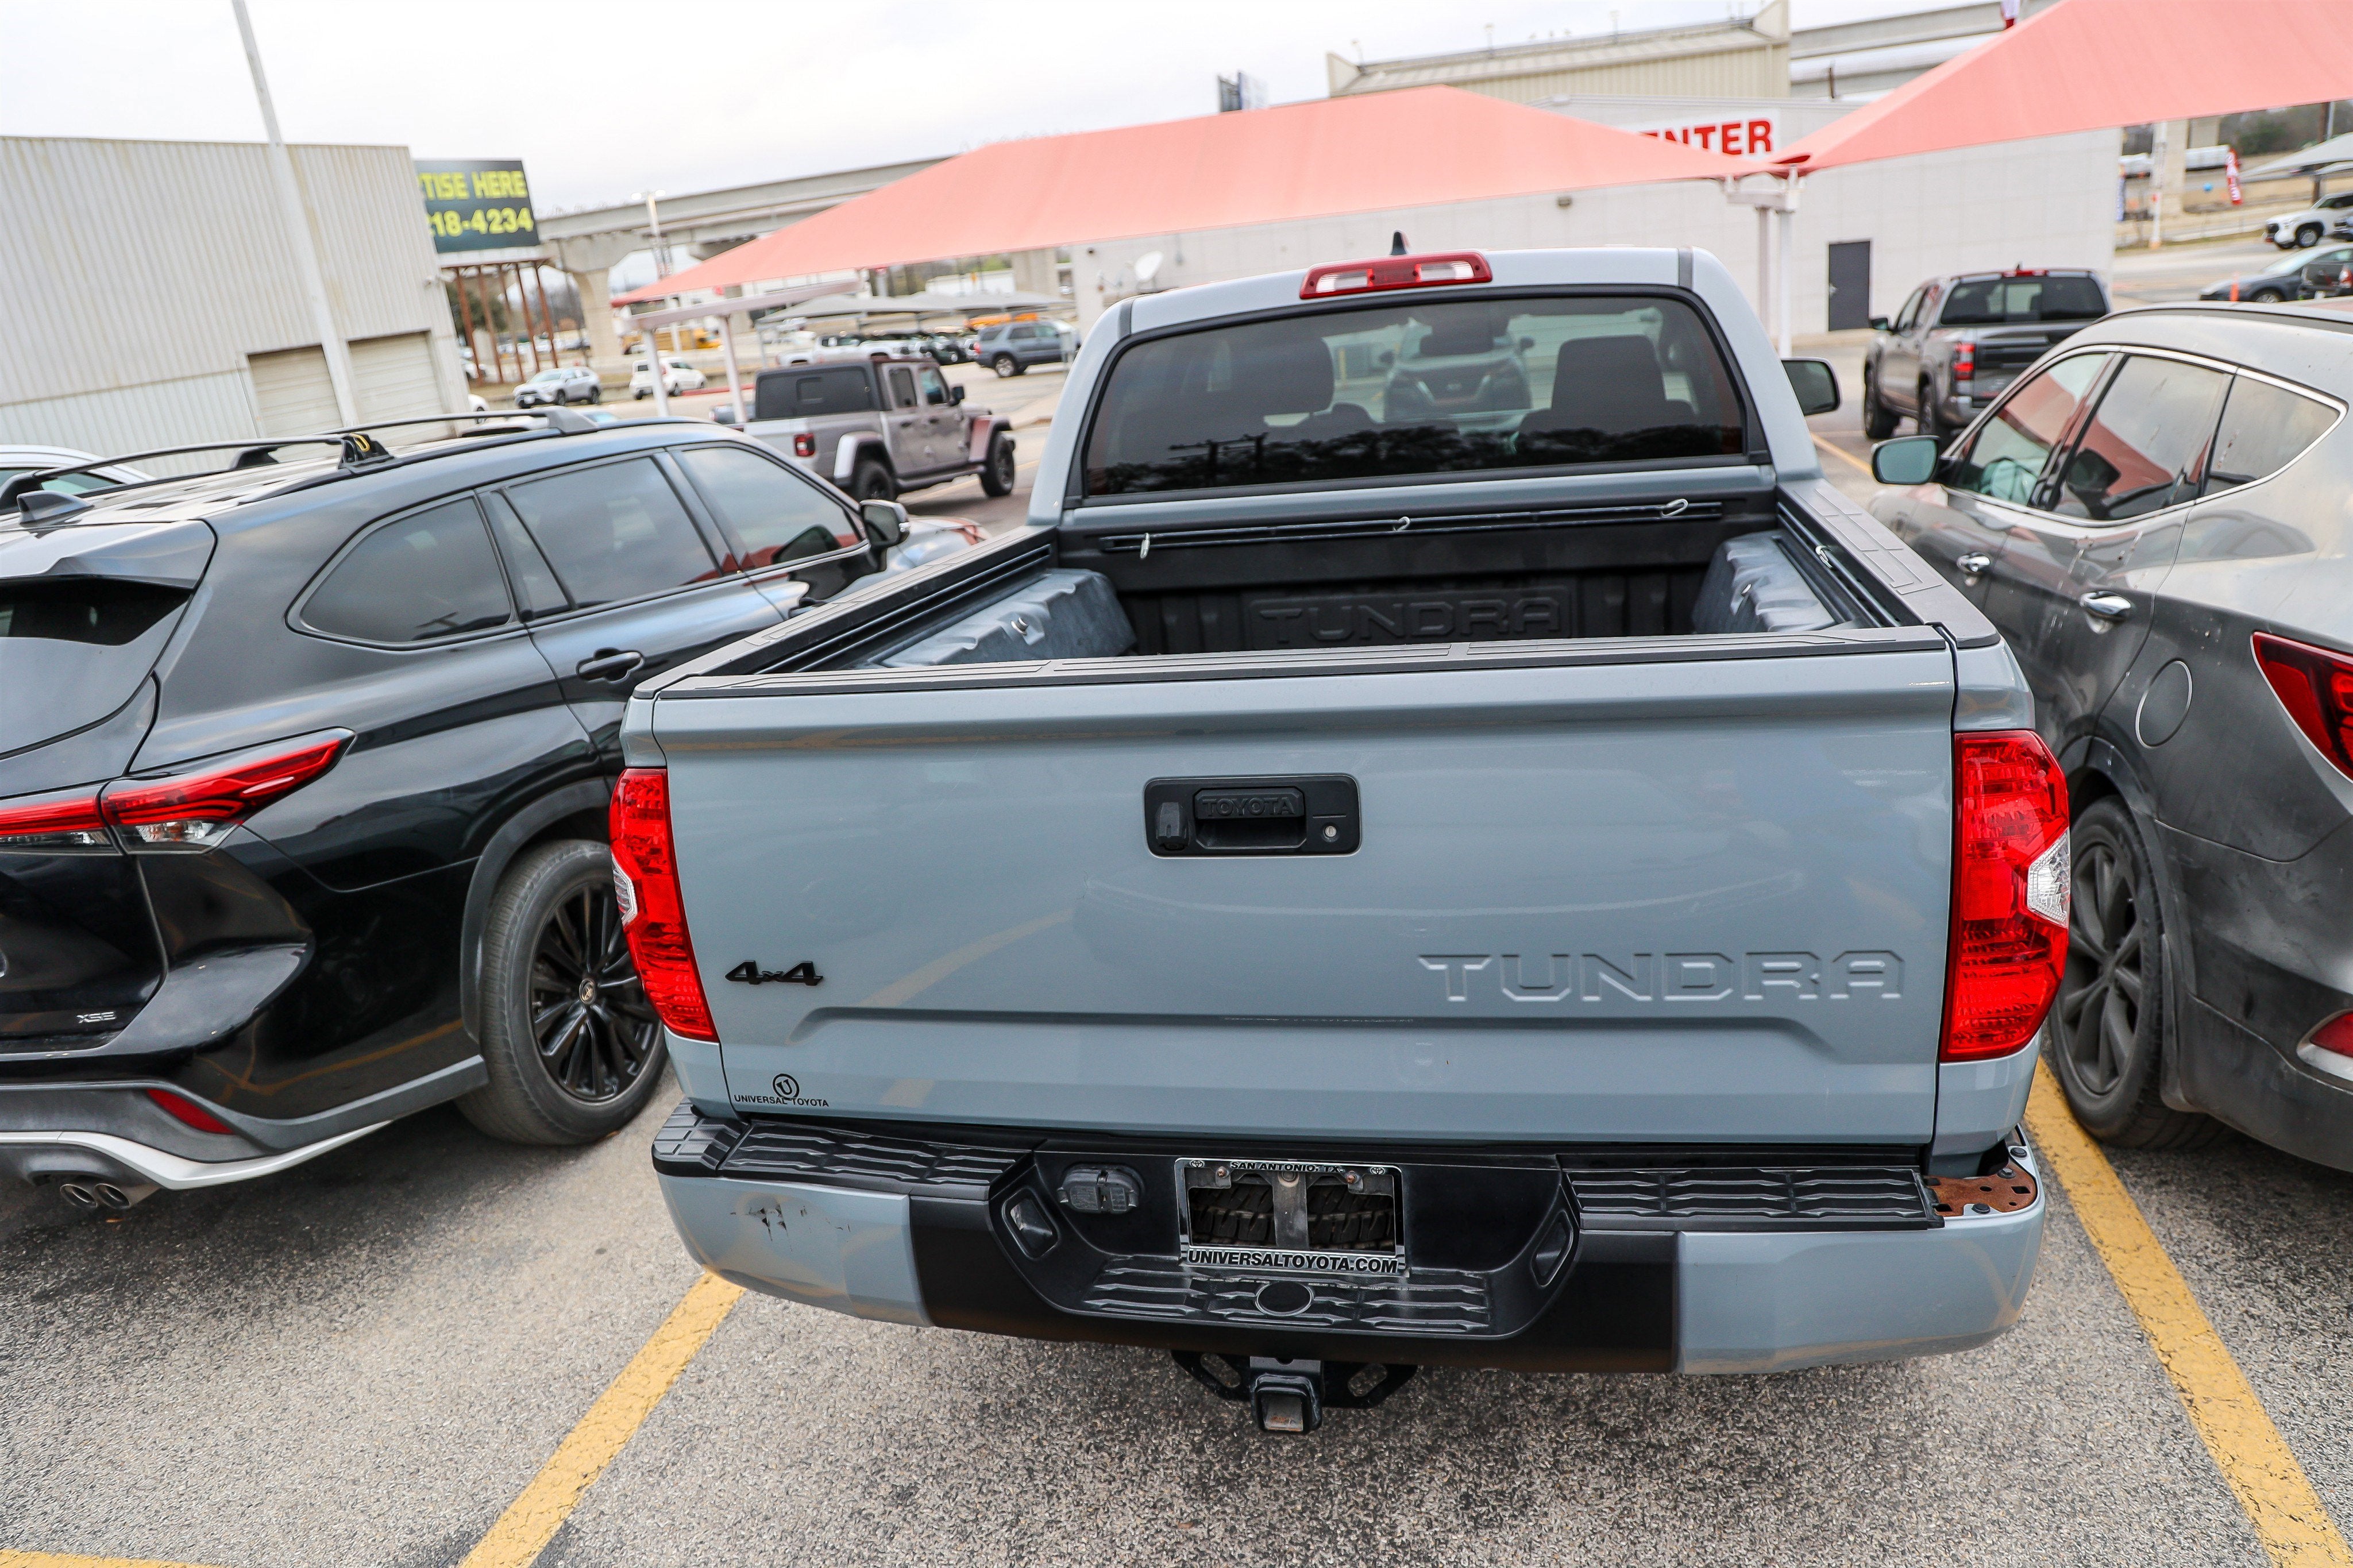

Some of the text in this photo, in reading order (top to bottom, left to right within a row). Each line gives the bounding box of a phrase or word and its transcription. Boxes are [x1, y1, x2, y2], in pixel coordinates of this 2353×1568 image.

[419, 171, 527, 200] TISE HERE
[427, 207, 534, 237] 18-4234
[1259, 596, 1559, 643] TUNDRA
[1202, 796, 1295, 817] TOYOTA
[1418, 950, 1904, 1002] TUNDRA
[76, 1011, 117, 1024] XSE
[734, 1094, 828, 1107] UNIVERSAL TOYOTA
[1230, 1161, 1256, 1169] SAN
[1188, 1250, 1398, 1274] UNIVERSALTOYOTA.COM
